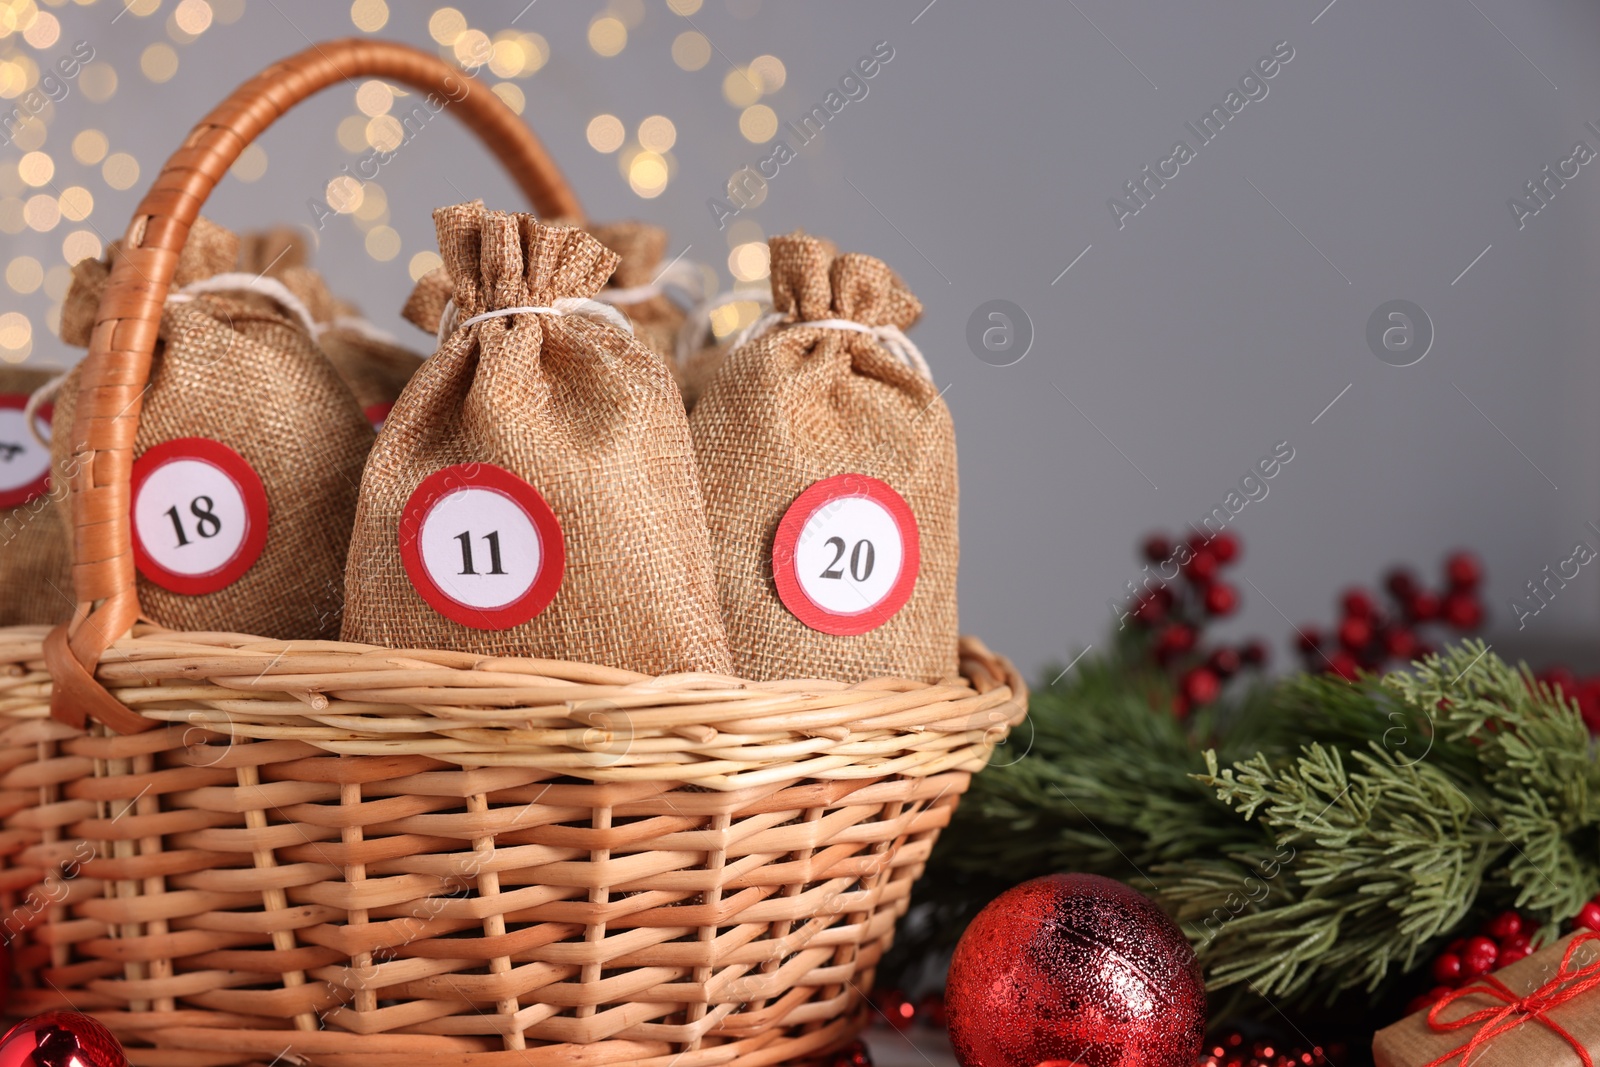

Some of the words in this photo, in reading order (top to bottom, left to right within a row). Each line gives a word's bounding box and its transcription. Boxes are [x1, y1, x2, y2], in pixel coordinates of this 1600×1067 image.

[162, 495, 222, 550] 18
[453, 530, 509, 575] 11
[819, 536, 875, 582] 20
